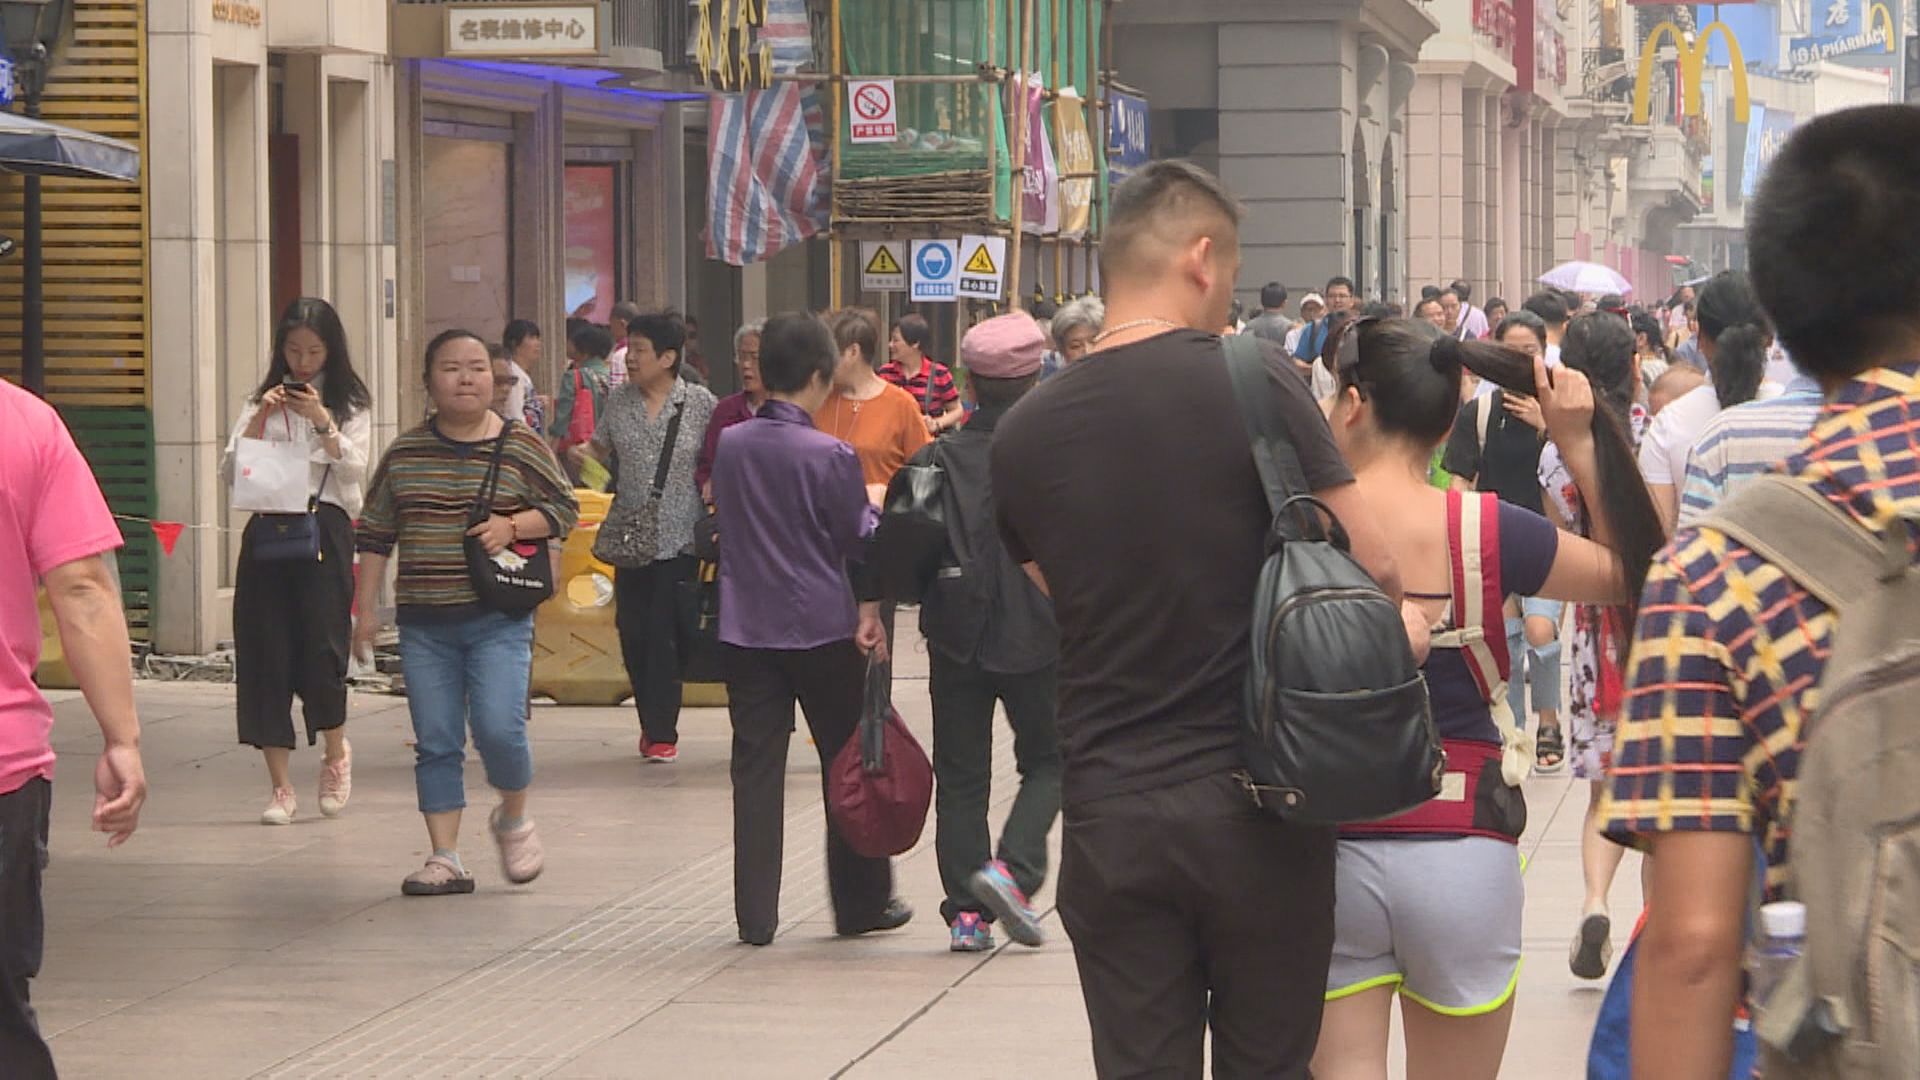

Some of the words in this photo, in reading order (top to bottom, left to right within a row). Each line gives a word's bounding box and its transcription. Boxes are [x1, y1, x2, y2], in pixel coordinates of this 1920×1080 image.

[459, 18, 585, 41] 名表维修中心
[1822, 27, 1888, 58] PHARMACY
